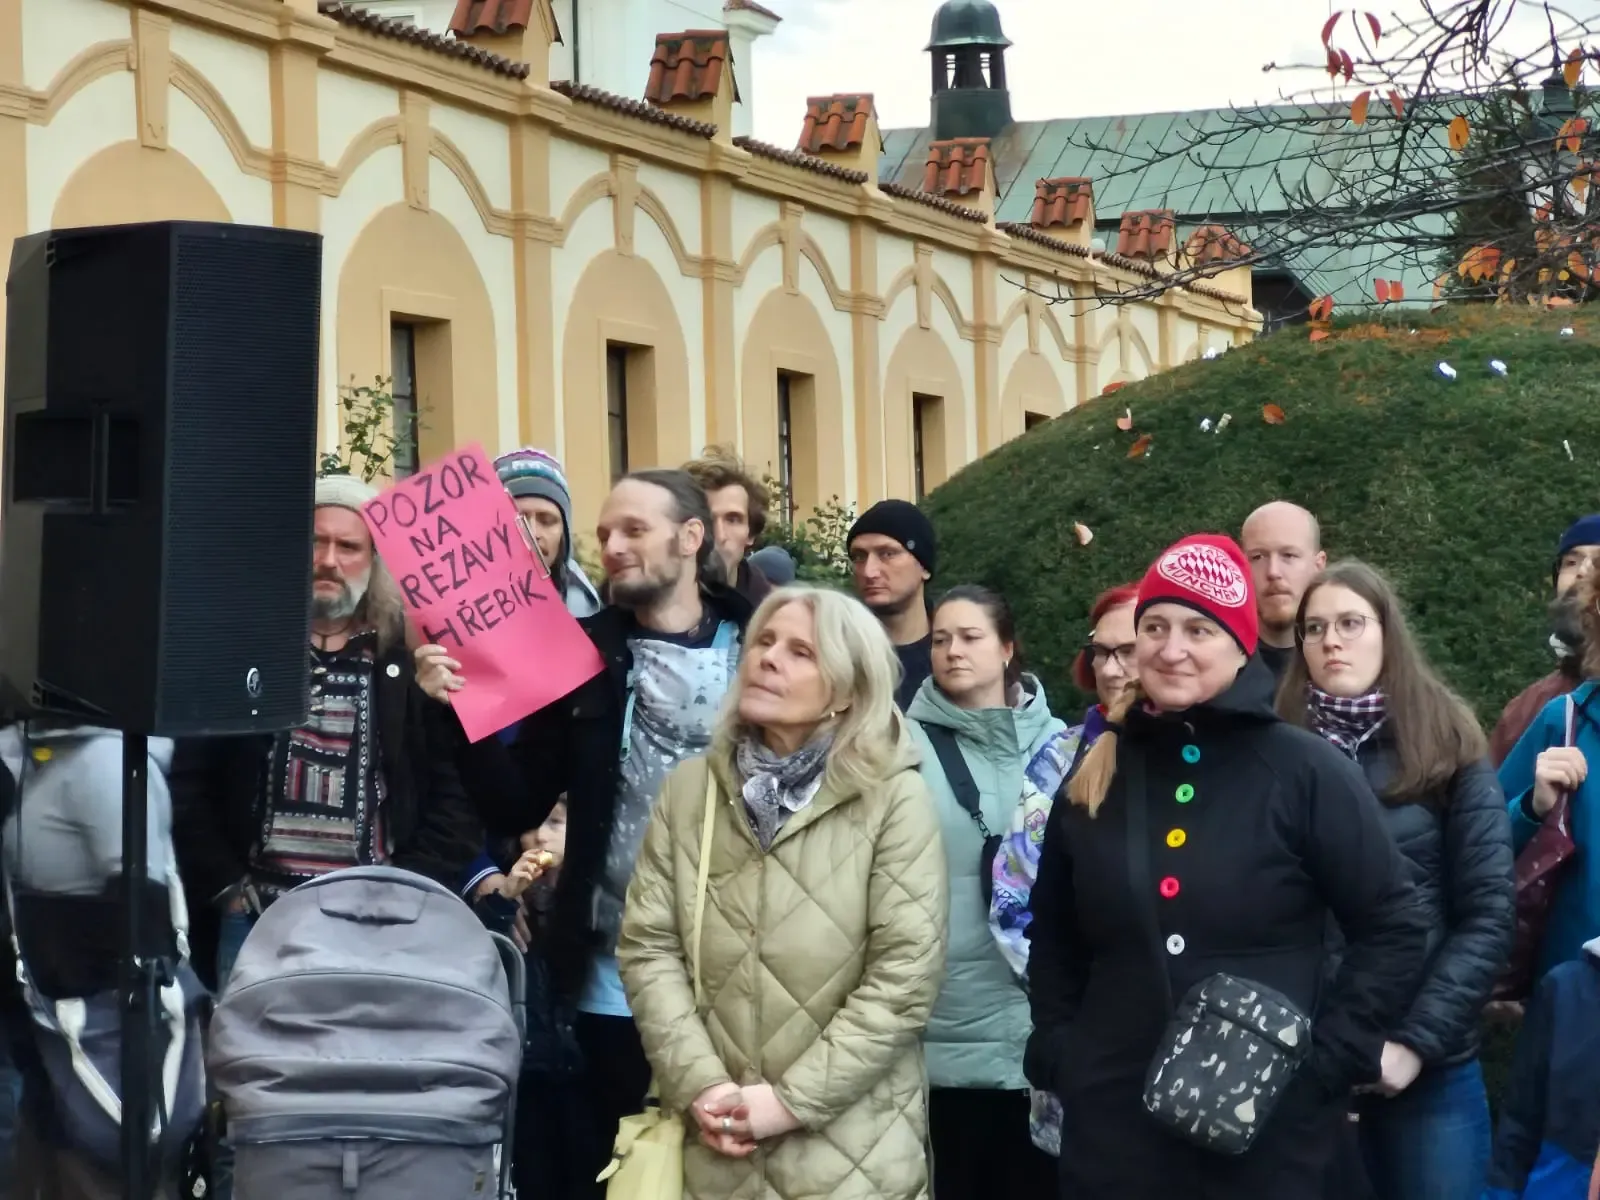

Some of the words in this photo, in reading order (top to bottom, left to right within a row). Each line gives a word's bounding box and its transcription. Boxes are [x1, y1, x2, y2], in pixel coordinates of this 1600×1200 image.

[365, 454, 490, 538] POZOR
[409, 514, 462, 557] NA
[399, 511, 514, 609] REZAVÝ
[422, 569, 548, 648] HŘEBÍK
